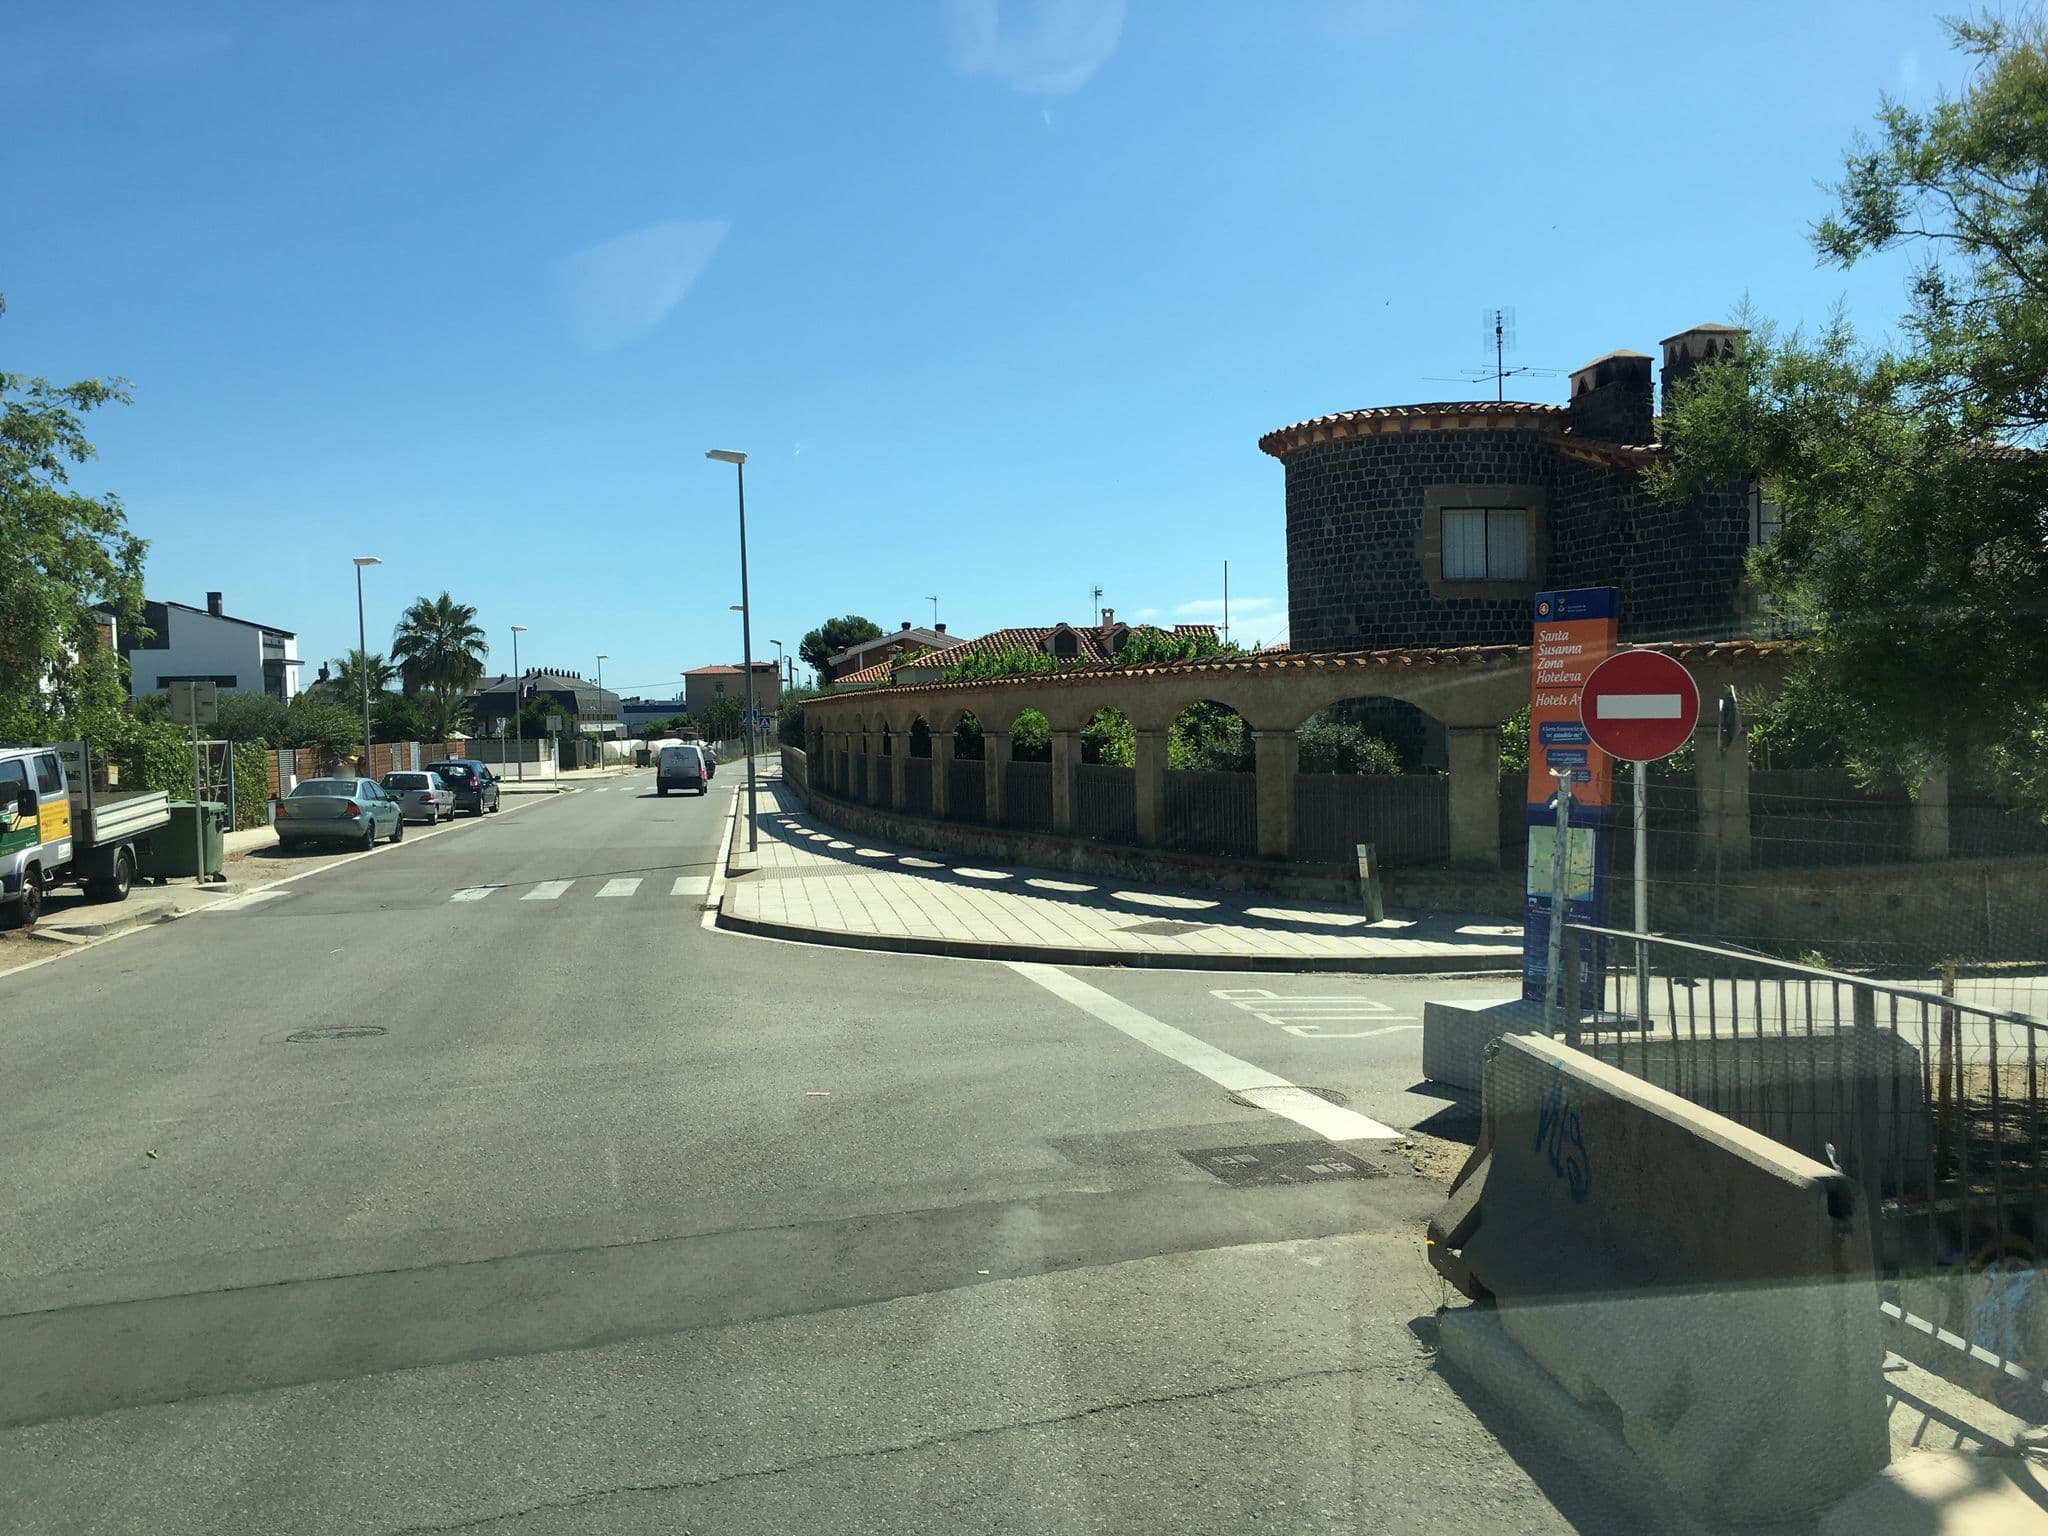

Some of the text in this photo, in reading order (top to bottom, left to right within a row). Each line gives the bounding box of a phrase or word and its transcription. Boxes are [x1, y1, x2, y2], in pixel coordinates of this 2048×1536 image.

[1538, 630, 1569, 642] Santa
[1537, 643, 1582, 656] Susanna
[1537, 657, 1564, 670] Zona
[1536, 670, 1581, 684] Hotelera
[1536, 693, 1568, 707] Hotels
